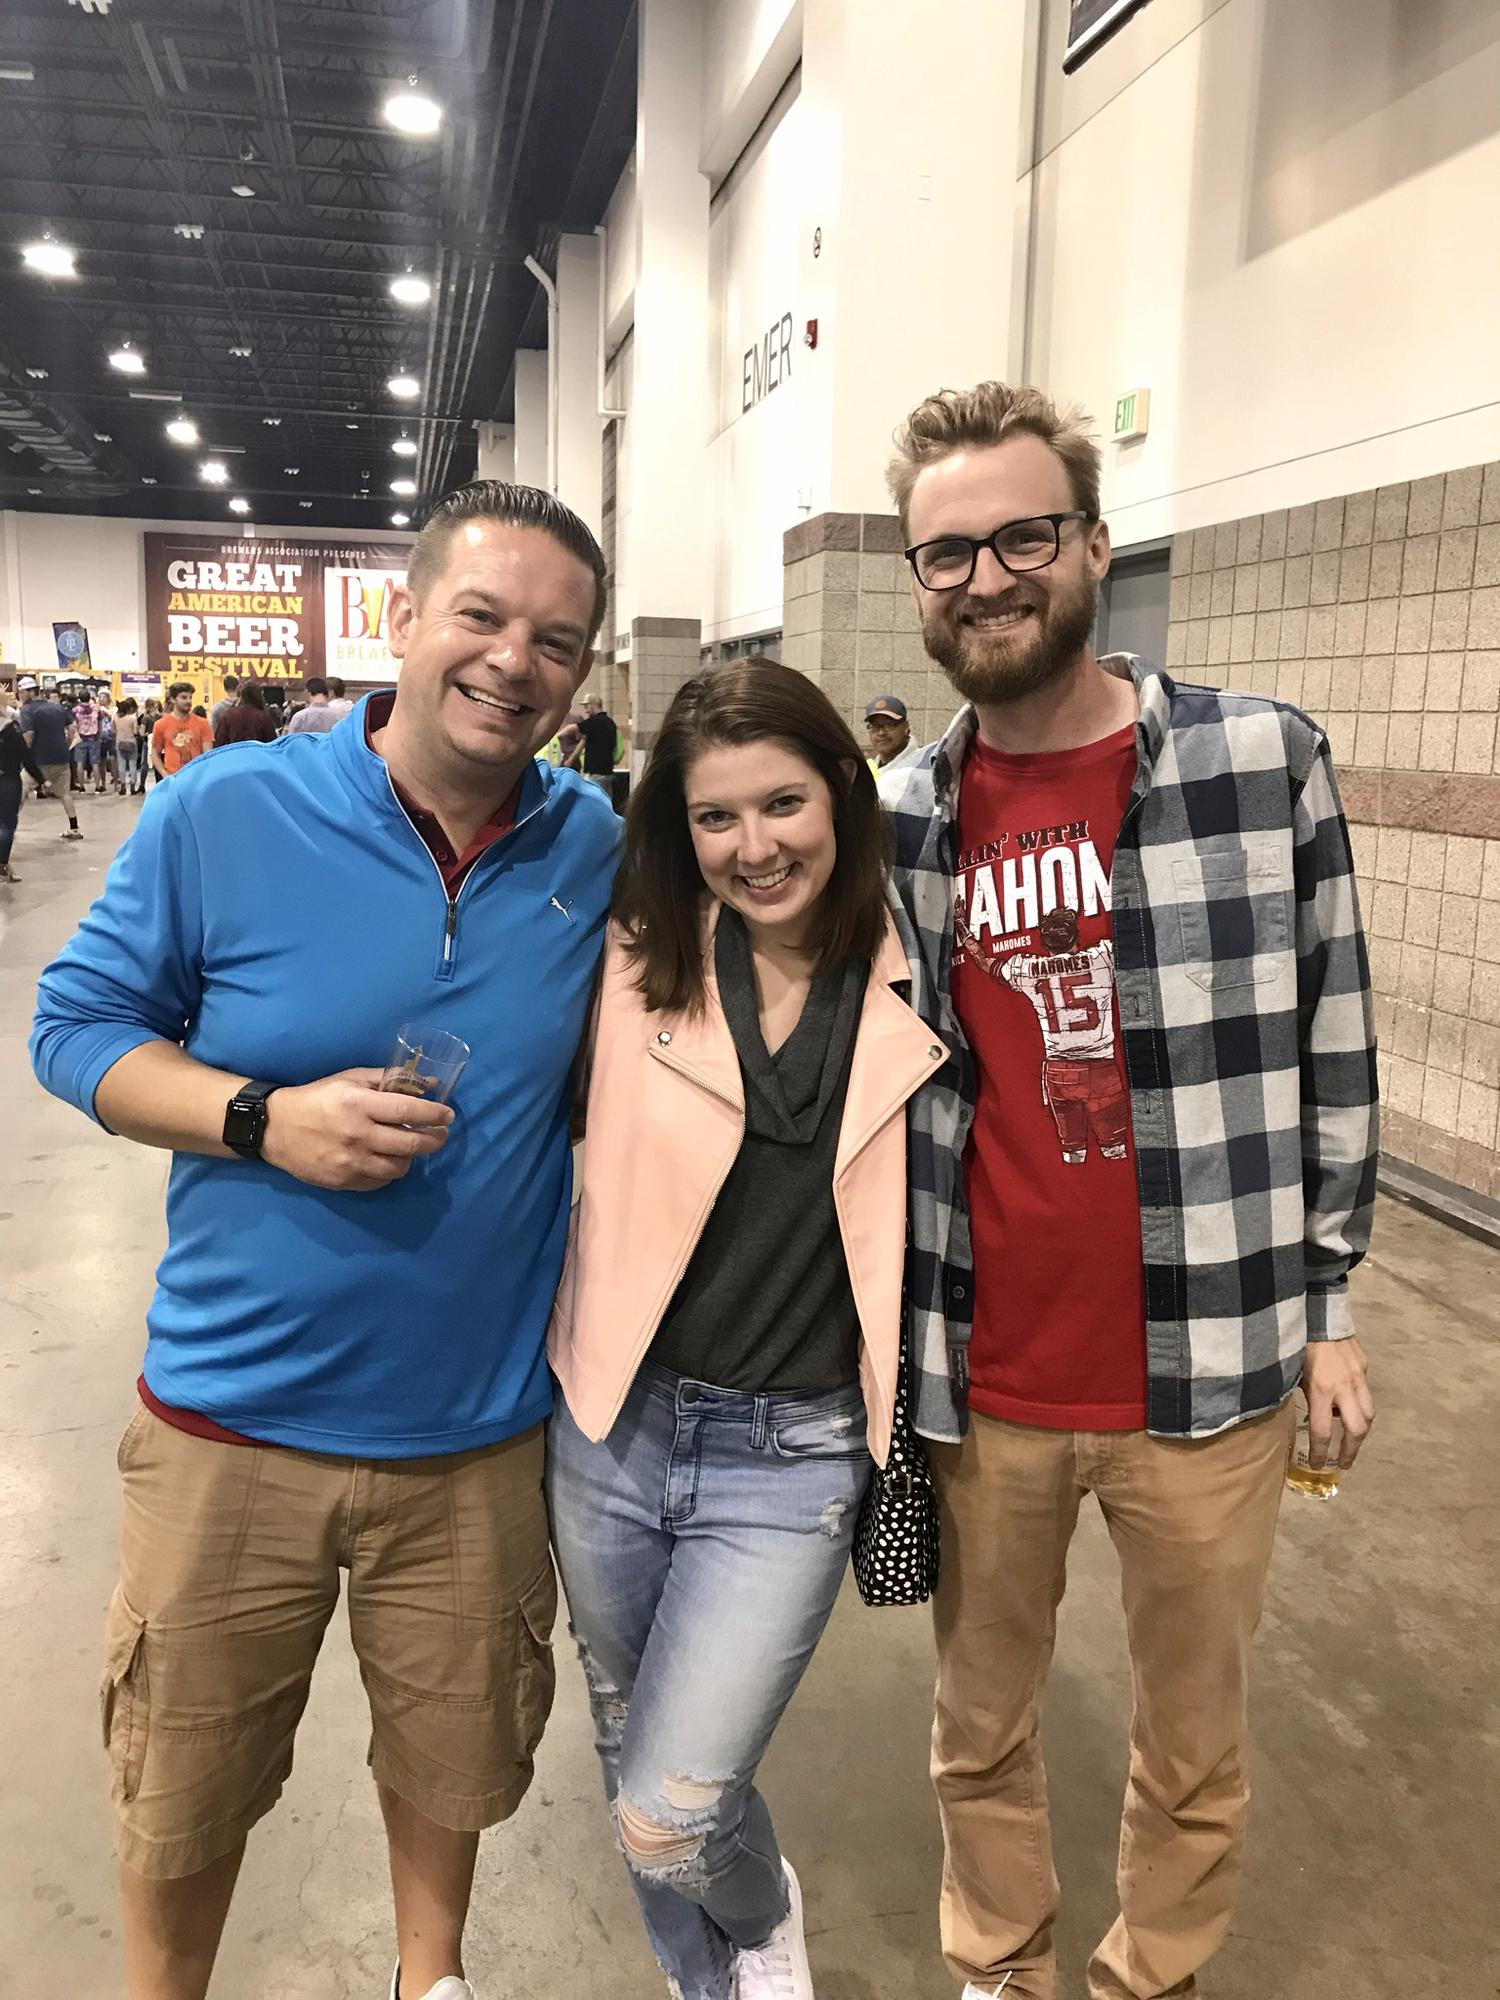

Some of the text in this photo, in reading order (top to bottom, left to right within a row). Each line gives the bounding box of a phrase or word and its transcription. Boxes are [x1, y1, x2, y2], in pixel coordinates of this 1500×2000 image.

[743, 312, 793, 414] EMER
[1114, 394, 1136, 433] EXIT
[167, 560, 302, 593] GREAT
[168, 592, 304, 614] AMERICAN
[168, 614, 304, 656] BEER
[169, 655, 303, 679] FESTIVAL
[1015, 820, 1090, 852] WITH
[992, 936, 1032, 953] MAHOMES
[1030, 956, 1091, 977] MAHOMES
[1035, 973, 1100, 1034] 15
